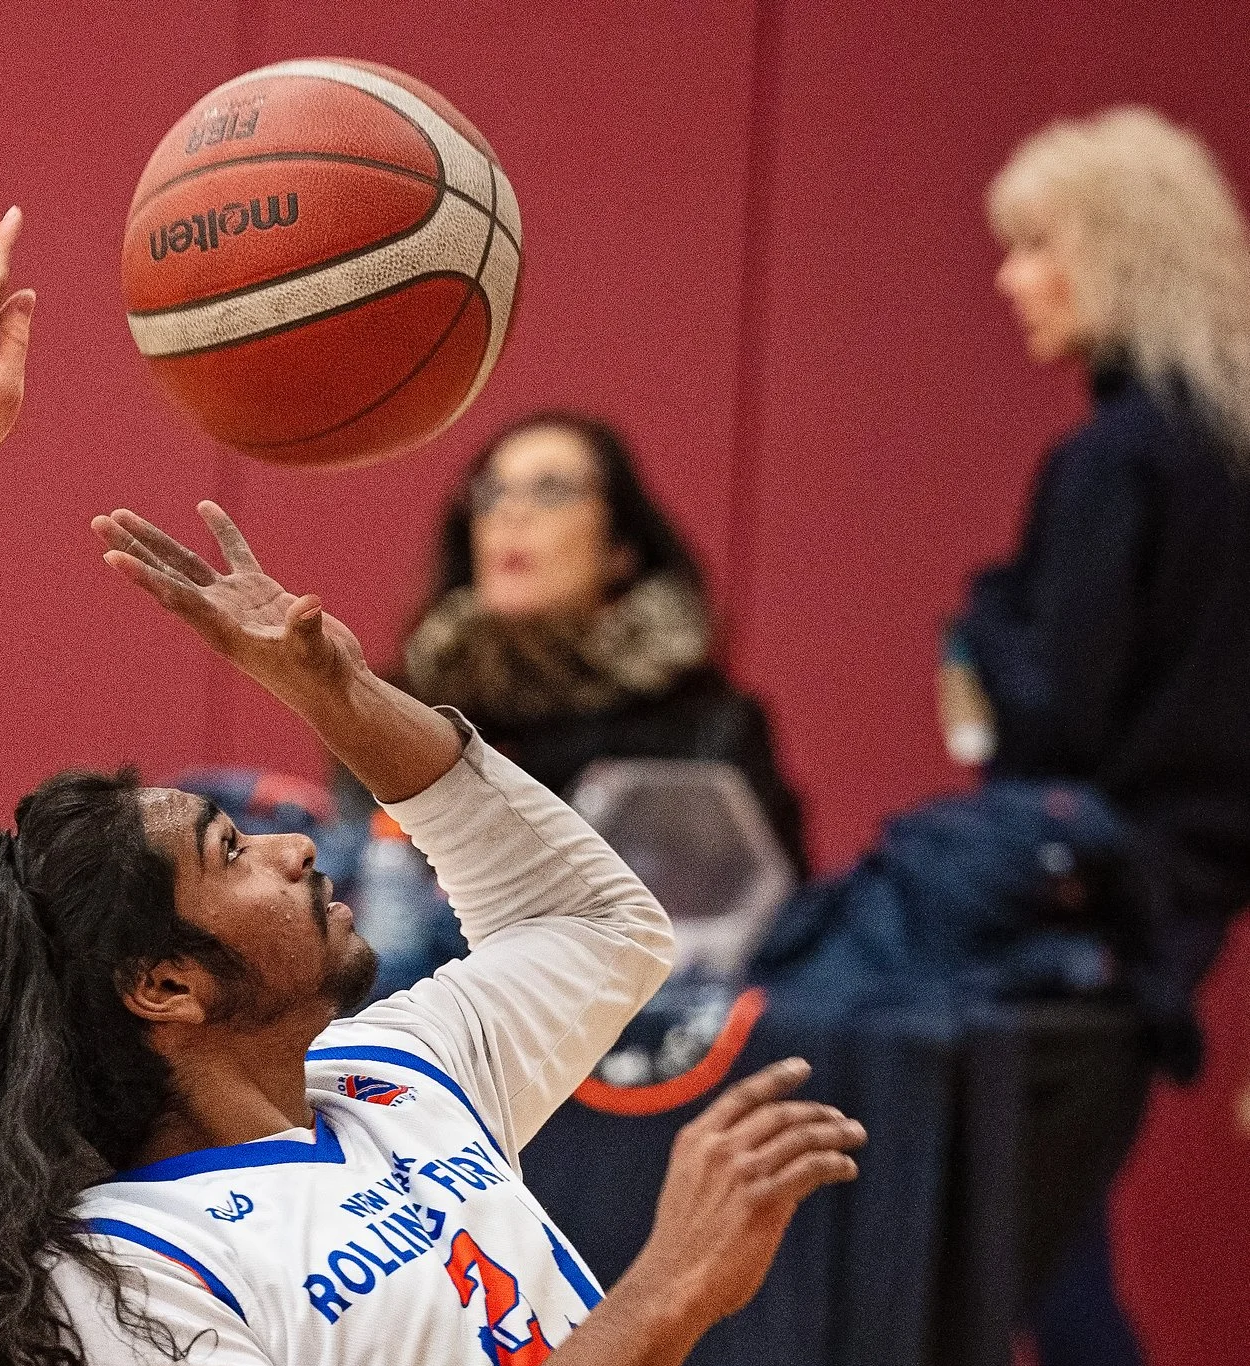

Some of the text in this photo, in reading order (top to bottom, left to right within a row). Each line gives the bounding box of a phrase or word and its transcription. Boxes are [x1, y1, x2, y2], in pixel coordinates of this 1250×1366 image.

[150, 191, 299, 261] molten
[303, 1141, 511, 1325] ROLLING FURY
